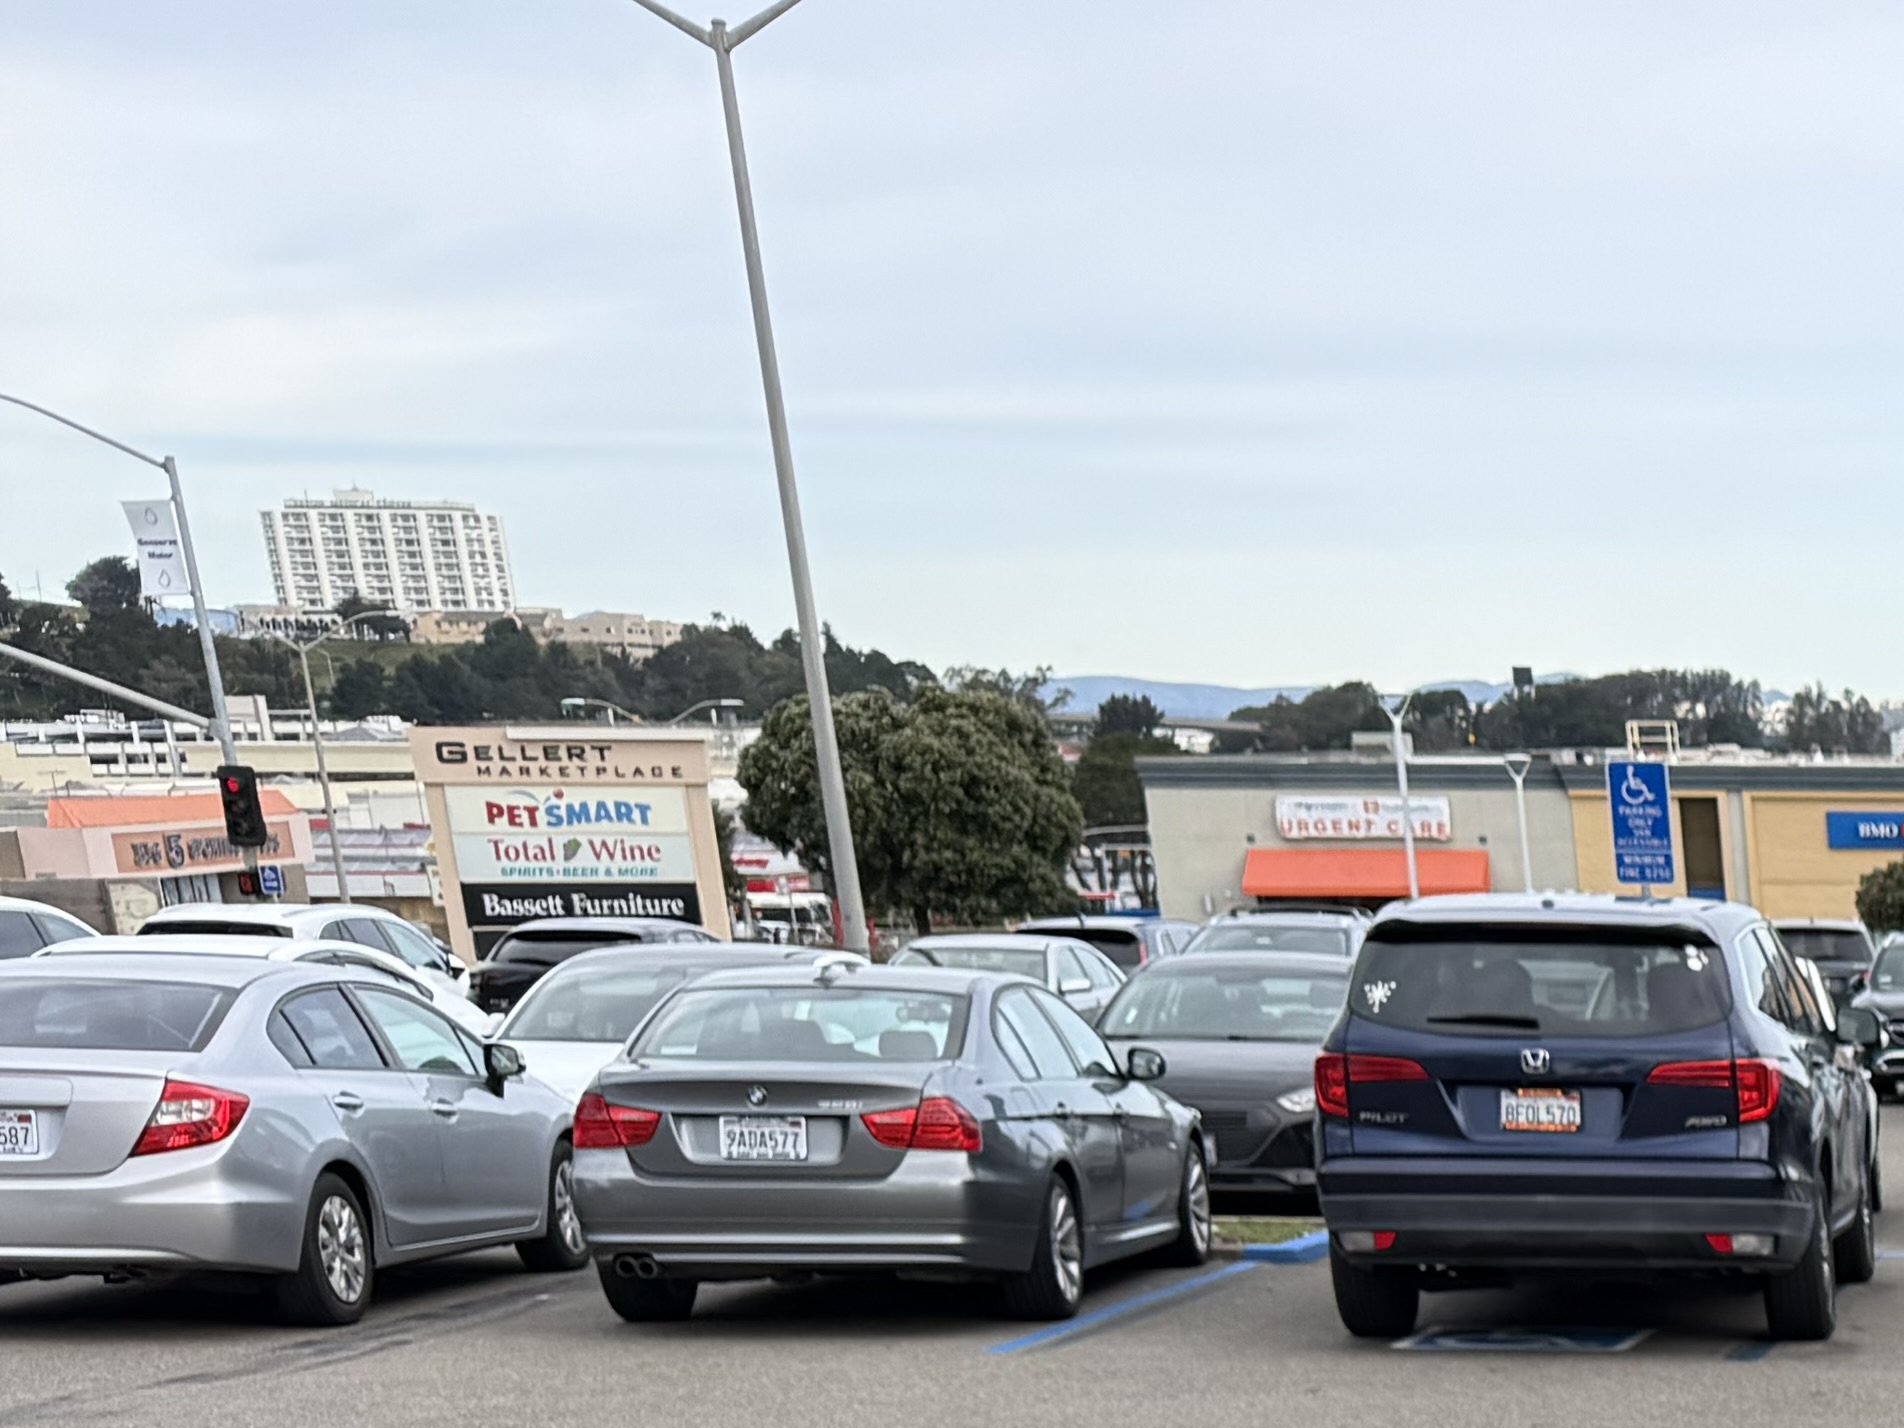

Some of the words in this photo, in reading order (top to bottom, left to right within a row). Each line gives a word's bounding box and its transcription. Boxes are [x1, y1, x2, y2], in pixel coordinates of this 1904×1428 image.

[435, 741, 612, 764] GELLERT
[476, 765, 684, 778] MARKETPLACE
[1280, 818, 1376, 838] URGENT
[1858, 821, 1899, 838] BMO
[162, 833, 185, 869] 5
[487, 837, 556, 862] Total
[588, 838, 662, 862] Wine
[482, 892, 564, 917] Bassett
[570, 892, 685, 917] Furniture
[1360, 1111, 1410, 1123] PILOT
